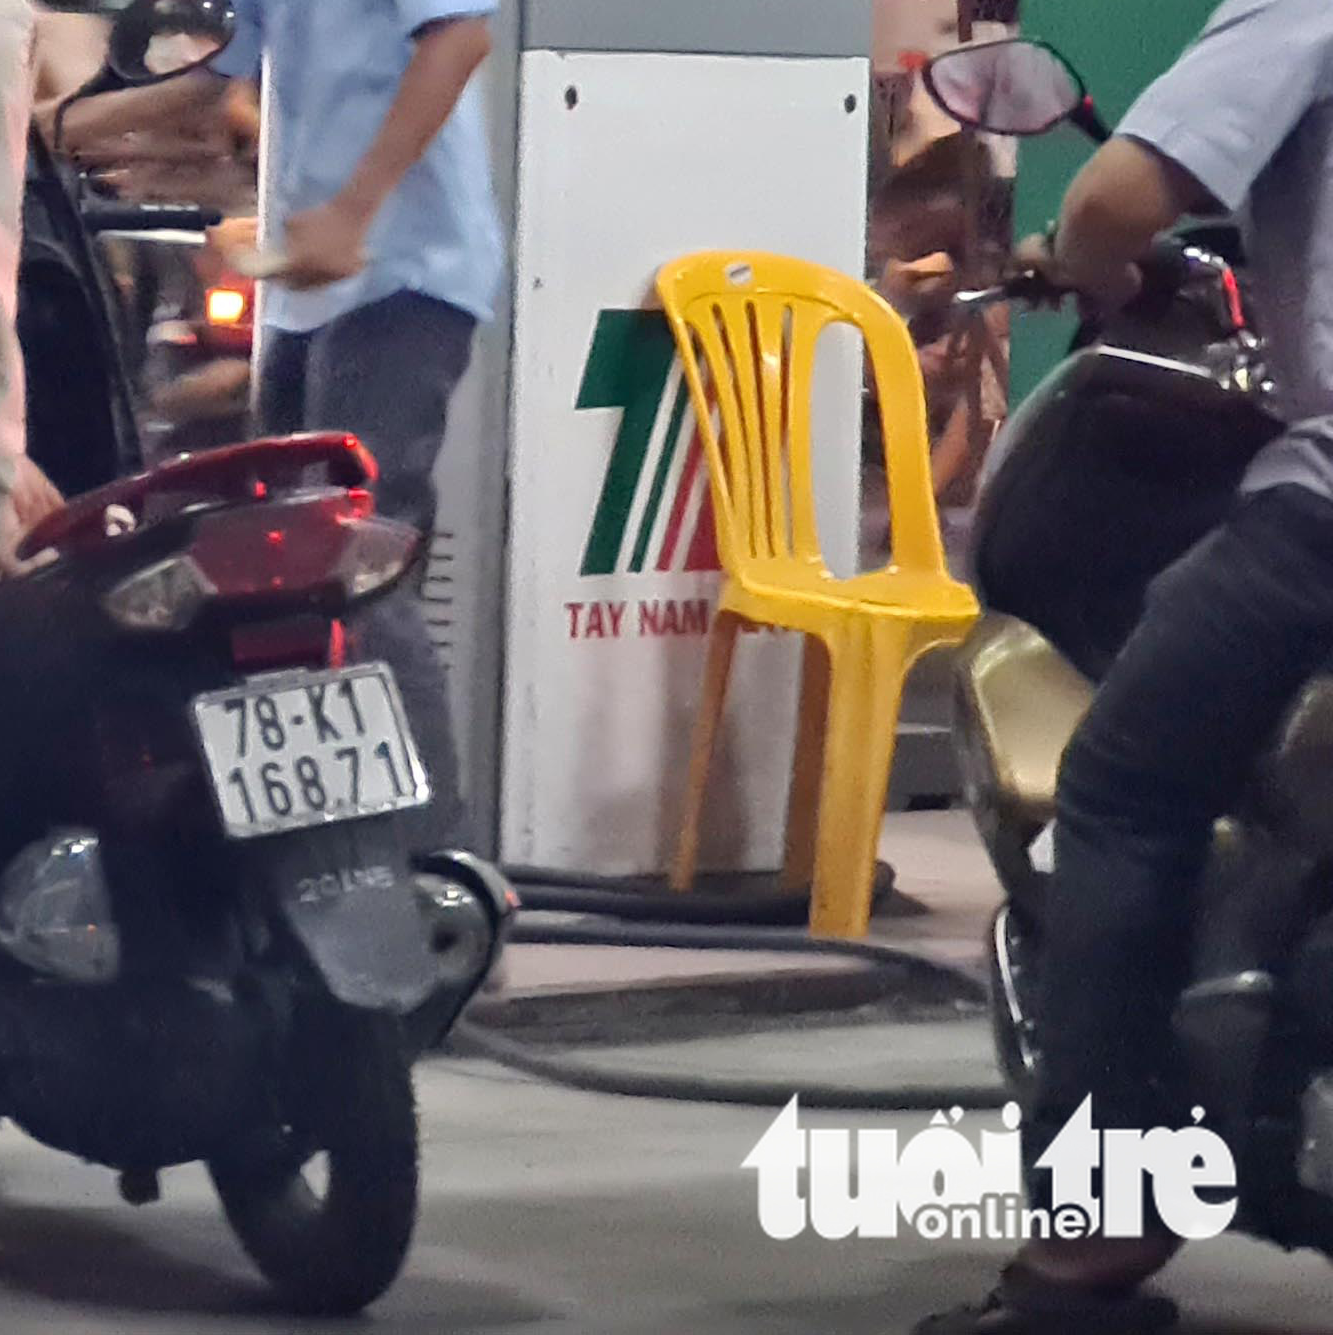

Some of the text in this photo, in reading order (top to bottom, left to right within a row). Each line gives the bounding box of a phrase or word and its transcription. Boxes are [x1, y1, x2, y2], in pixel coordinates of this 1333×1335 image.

[565, 598, 710, 638] TAY NAM
[224, 677, 365, 759] 78-K1
